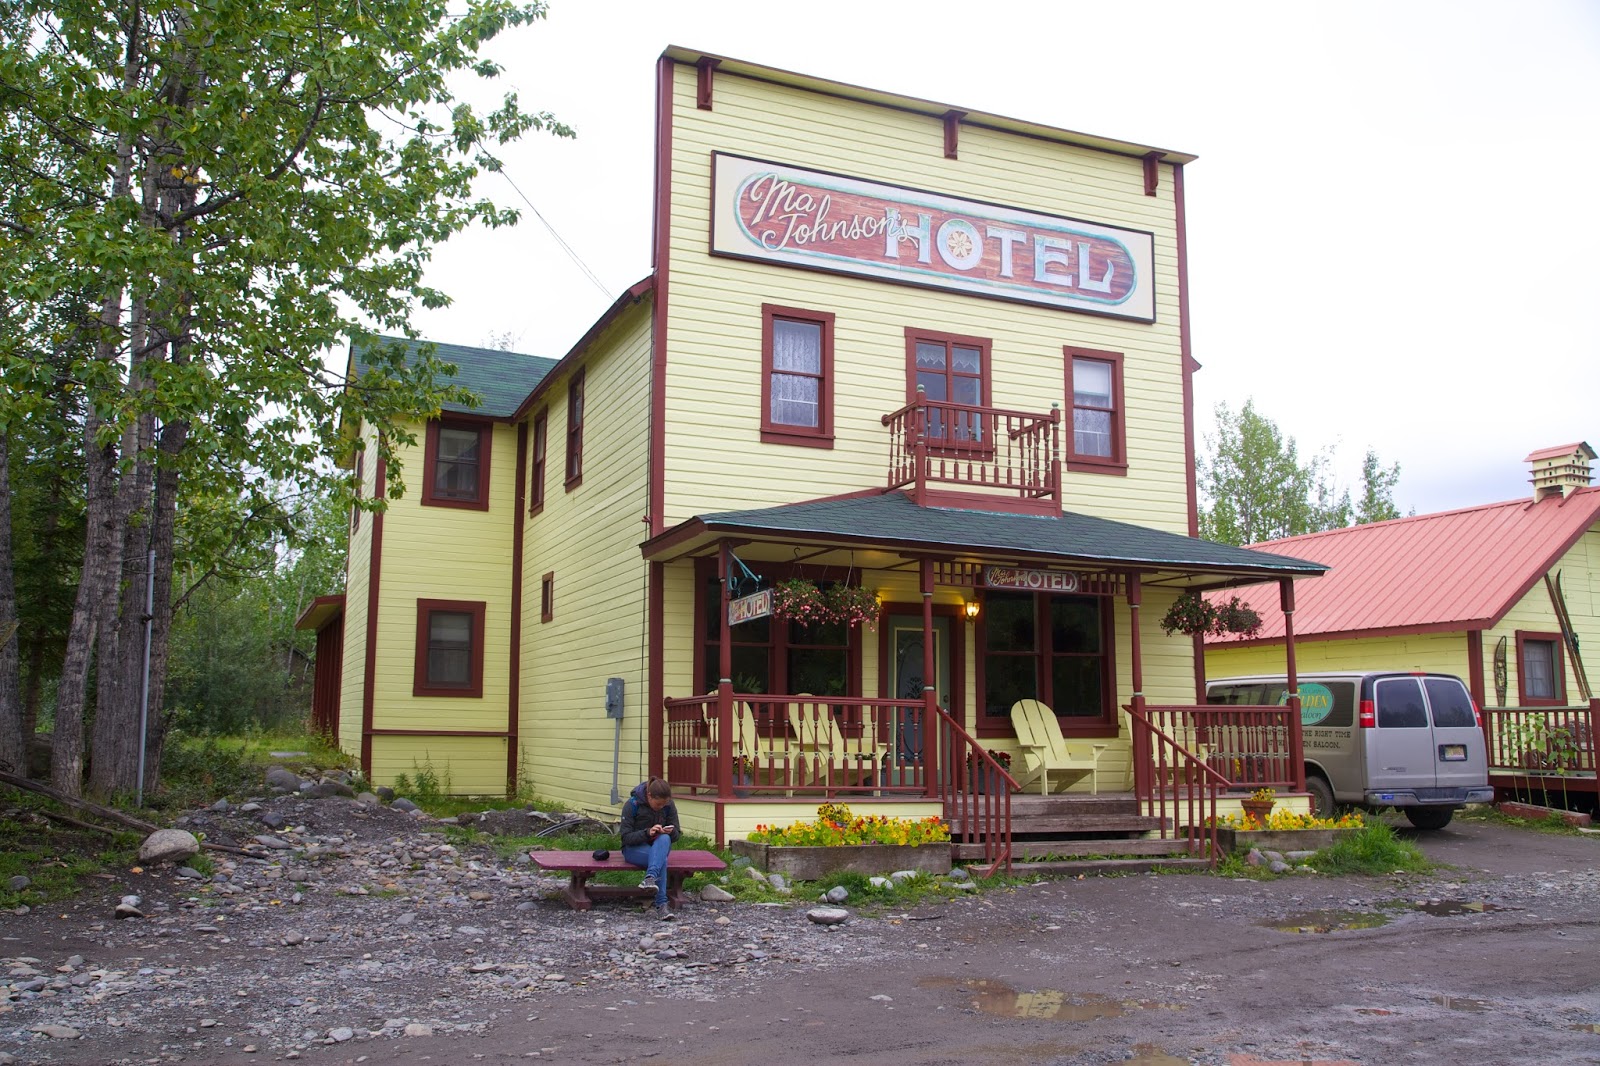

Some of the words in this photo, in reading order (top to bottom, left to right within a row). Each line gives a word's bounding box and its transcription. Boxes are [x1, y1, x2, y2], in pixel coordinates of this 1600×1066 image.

[750, 173, 816, 226] Ma
[762, 194, 919, 250] Johnson's
[884, 207, 1115, 294] HOTEL
[1015, 570, 1073, 590] HOTEL
[740, 594, 768, 619] HOTEL
[1299, 695, 1328, 708] LDEN
[1300, 706, 1322, 720] aloon
[1314, 730, 1333, 738] RIGHT
[1334, 731, 1352, 739] TIME
